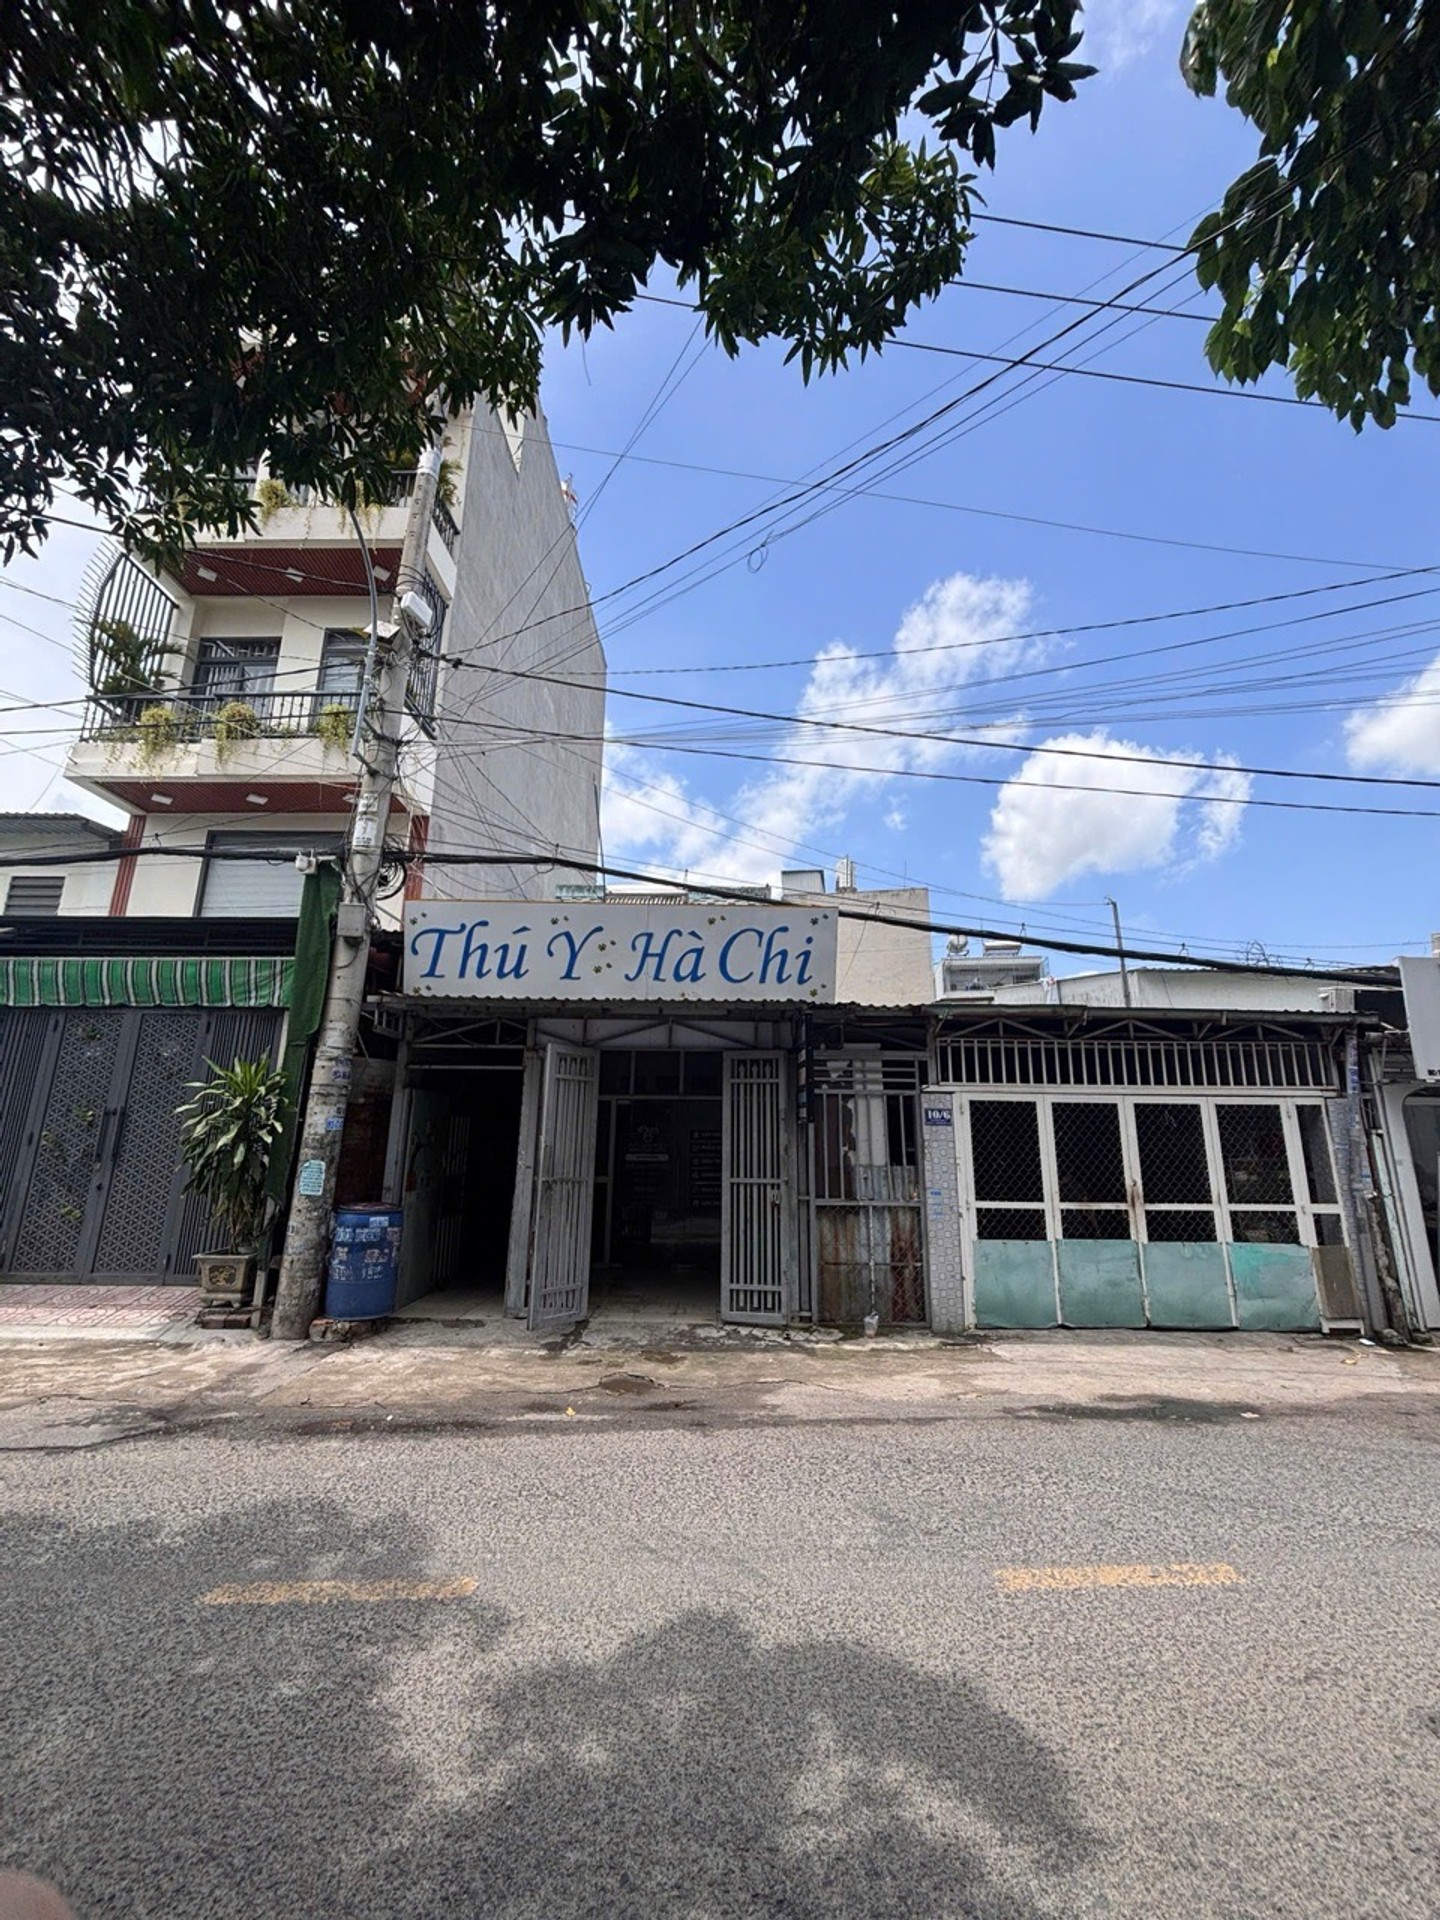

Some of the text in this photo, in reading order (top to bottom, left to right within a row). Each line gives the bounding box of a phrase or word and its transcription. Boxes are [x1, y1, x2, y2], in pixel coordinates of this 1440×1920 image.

[410, 919, 816, 986] Thú Y Hà Chi
[927, 1109, 951, 1120] 10/6
